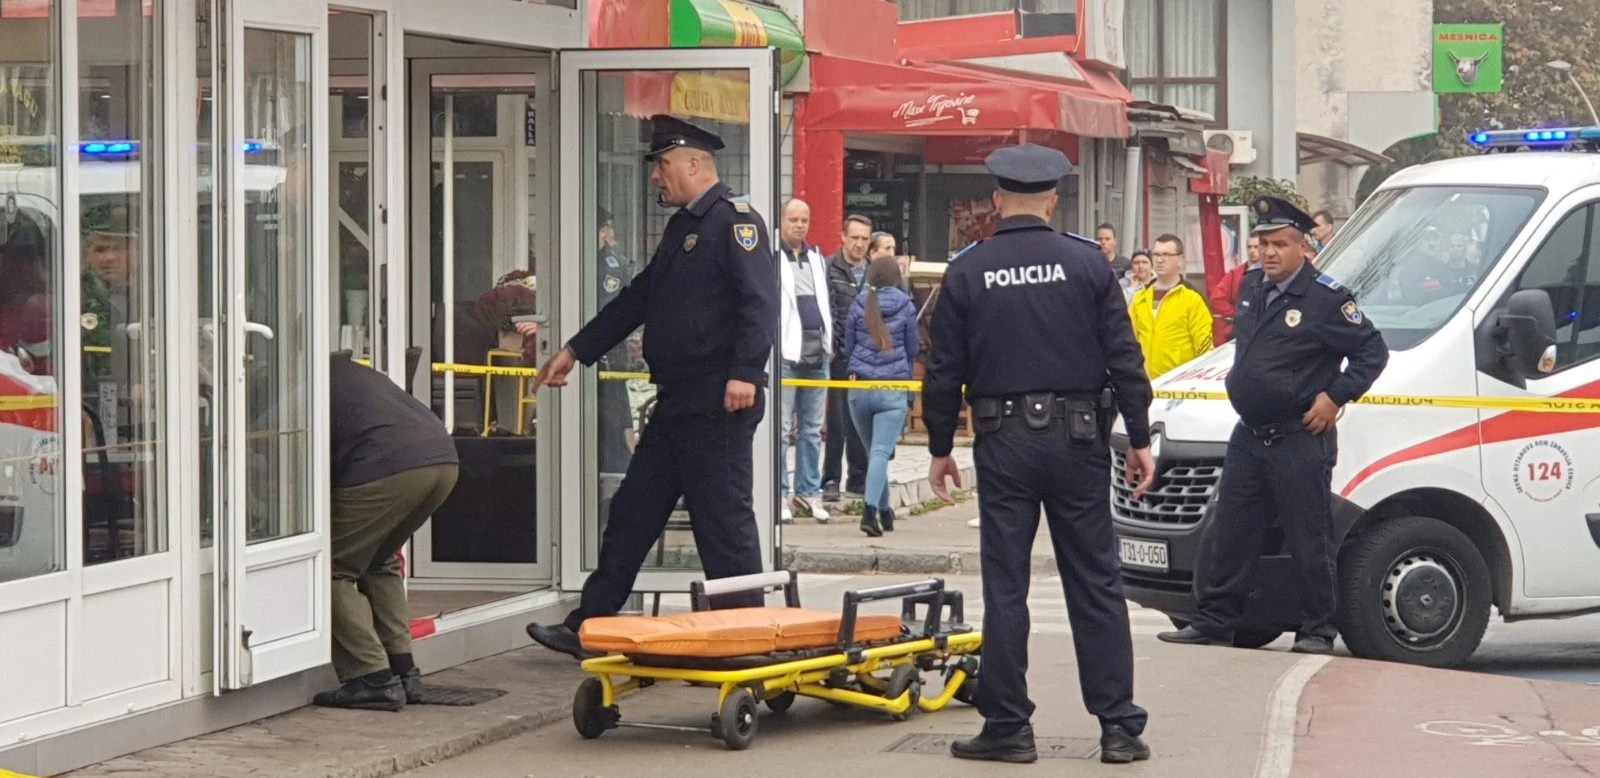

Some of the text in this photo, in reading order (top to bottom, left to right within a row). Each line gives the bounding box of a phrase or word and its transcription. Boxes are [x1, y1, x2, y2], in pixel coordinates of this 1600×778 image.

[1438, 33, 1497, 41] MESNICA
[983, 263, 1067, 289] POLICIJA
[1527, 461, 1562, 481] 124
